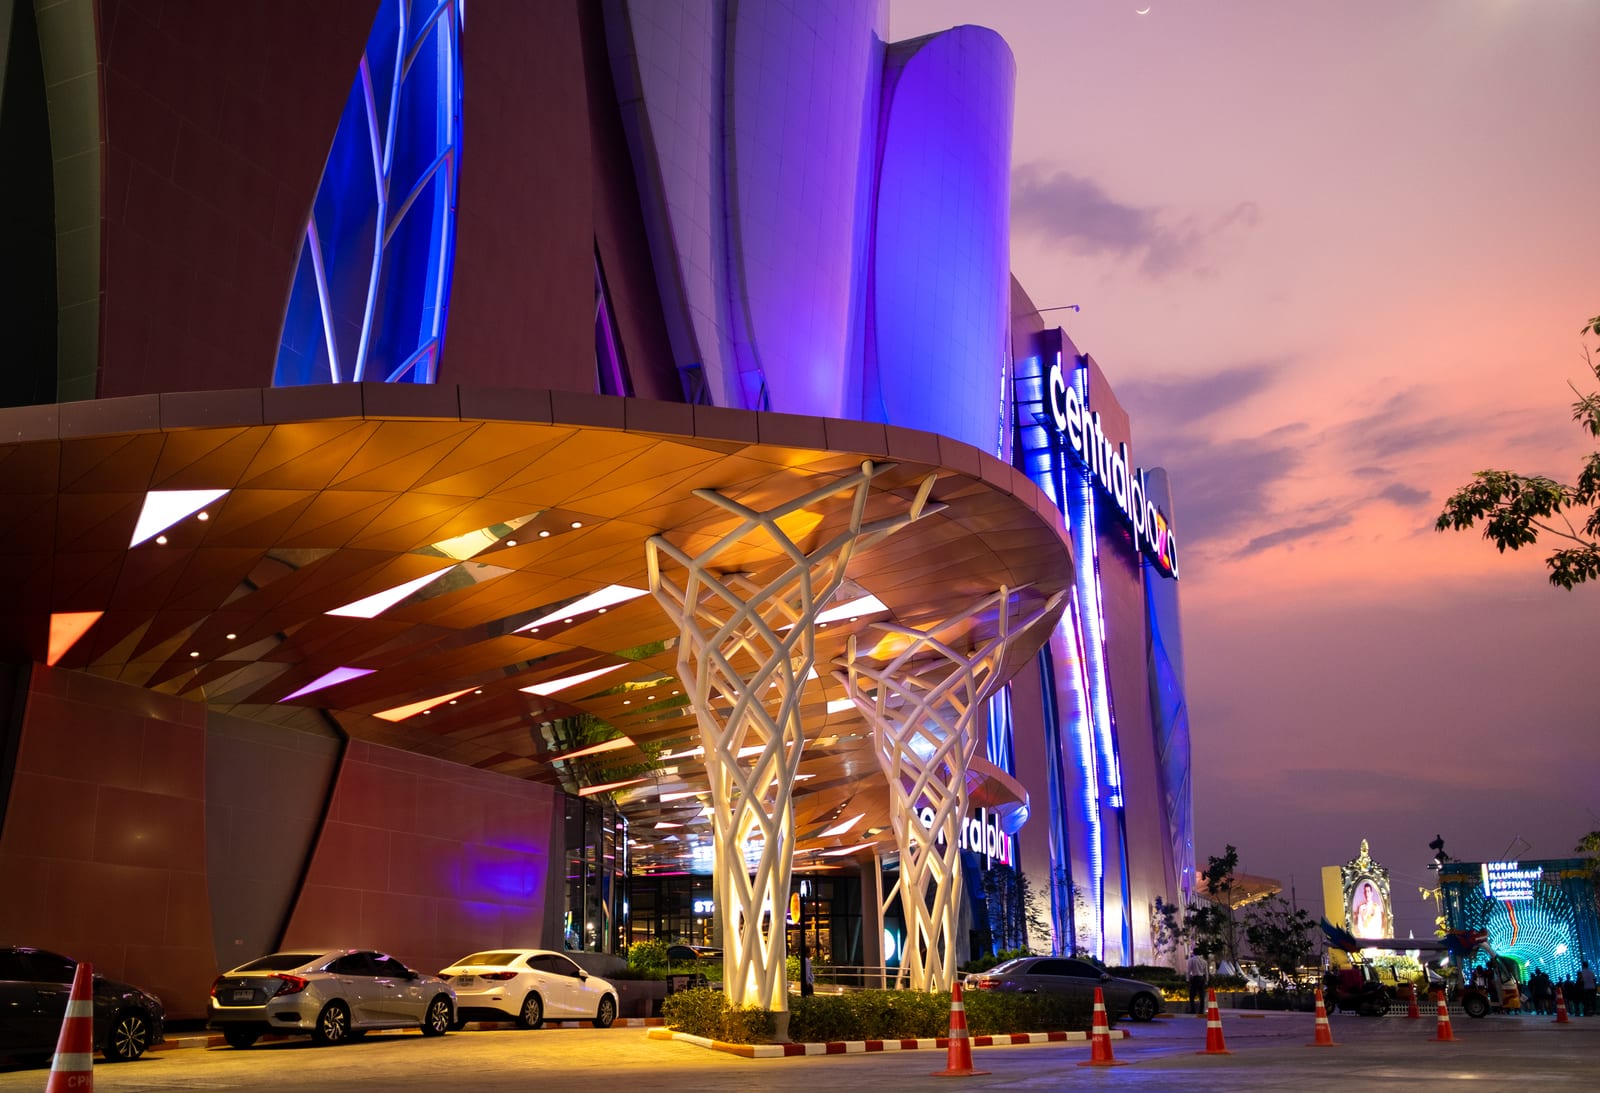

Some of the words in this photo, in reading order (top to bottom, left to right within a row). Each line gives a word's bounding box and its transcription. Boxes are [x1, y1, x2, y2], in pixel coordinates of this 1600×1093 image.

[1050, 364, 1180, 581] centralplaza
[1488, 862, 1518, 871] KORAT
[1489, 871, 1541, 880] ILLUMINANT
[1491, 880, 1532, 889] FESTIVAL
